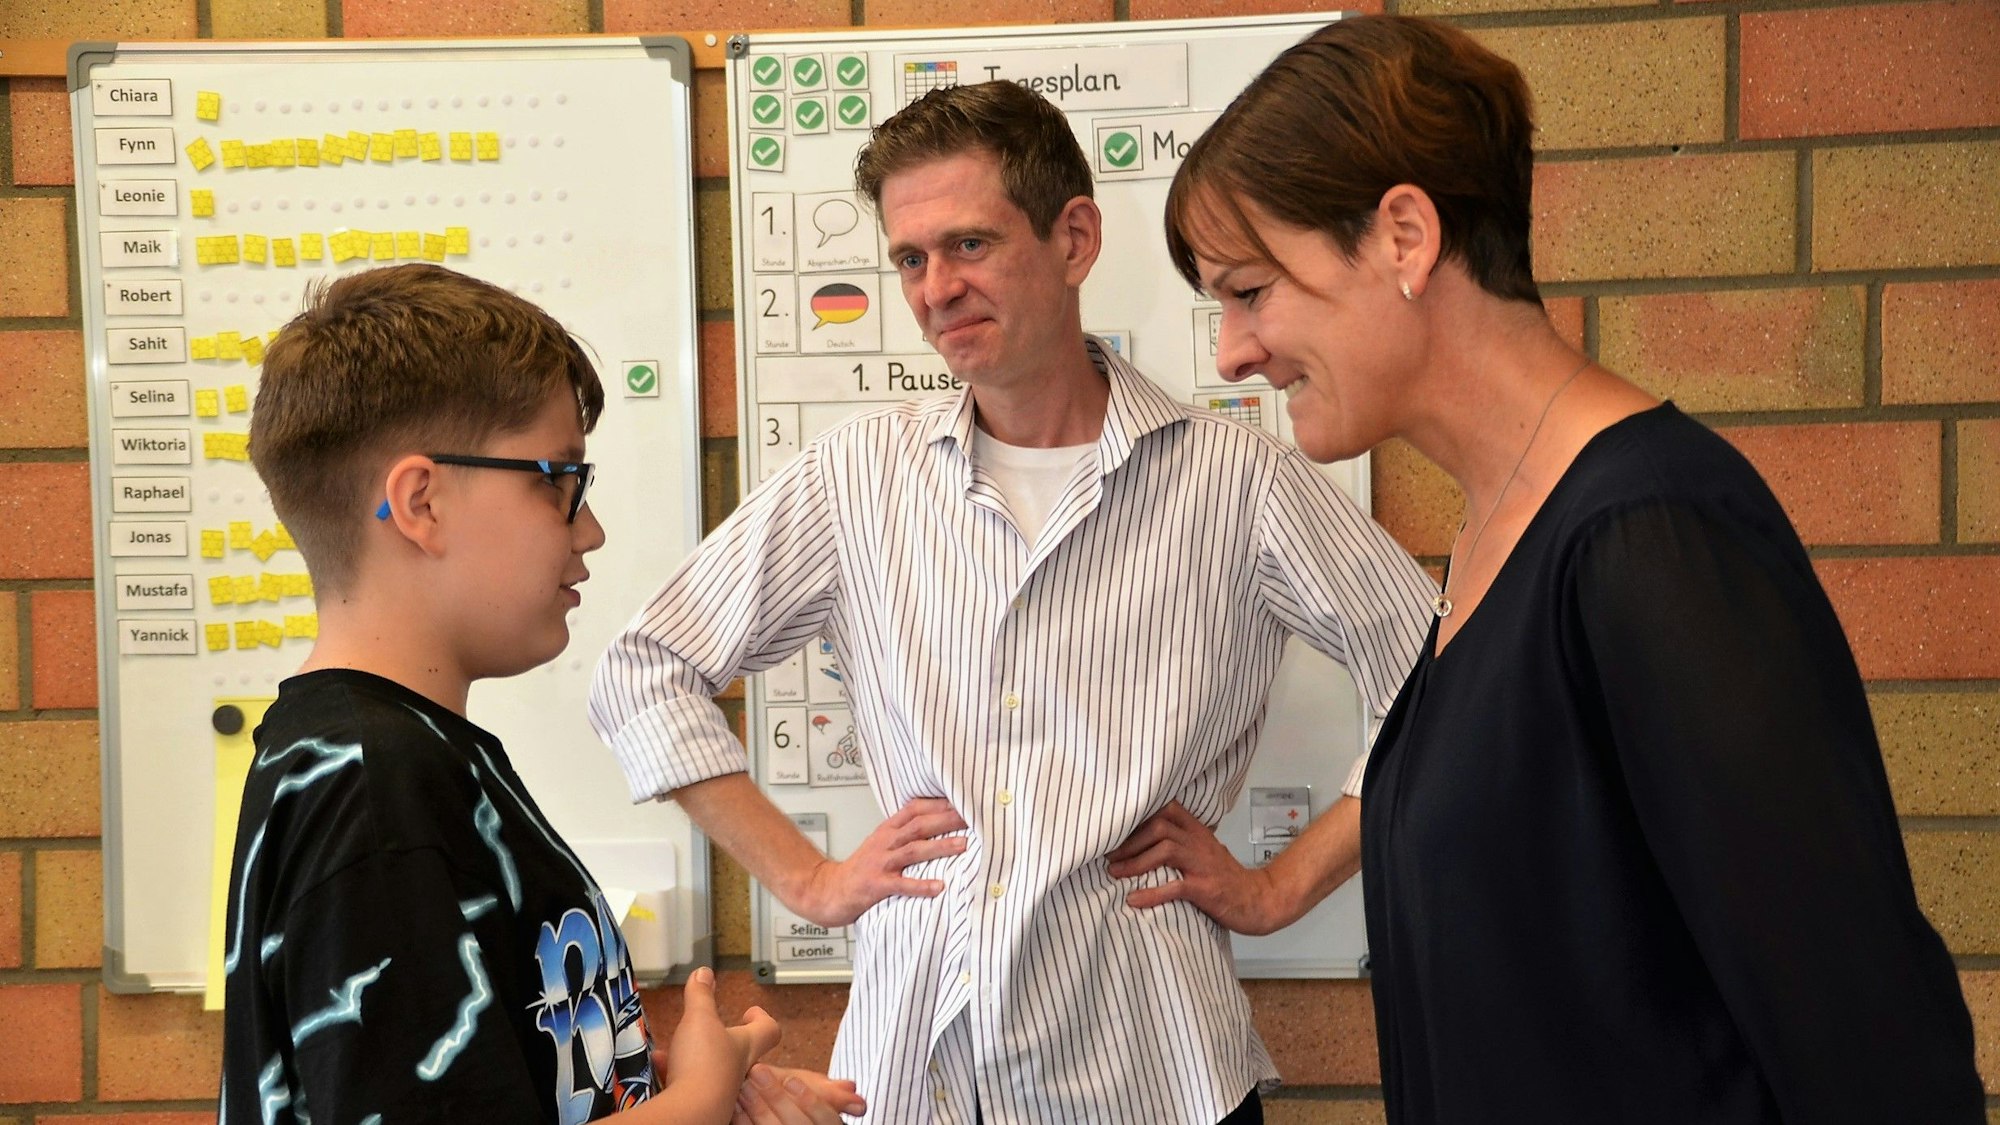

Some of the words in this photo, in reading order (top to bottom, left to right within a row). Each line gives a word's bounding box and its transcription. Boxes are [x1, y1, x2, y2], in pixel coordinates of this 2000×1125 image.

[109, 88, 158, 103] Chiara
[119, 137, 156, 154] Fynn
[1153, 129, 1191, 160] Mo
[114, 189, 165, 203] Leonie
[761, 206, 787, 236] 1.
[123, 240, 162, 254] Maik
[120, 289, 172, 303] Robert
[761, 288, 789, 318] 2.
[129, 337, 168, 351] Sahit
[826, 339, 856, 349] Deutsch
[852, 363, 870, 392] 1.
[888, 362, 963, 392] Pause
[129, 390, 175, 404] Selina
[765, 417, 793, 447] 3.
[121, 438, 187, 452] Wiktoria
[123, 485, 185, 502] Raphael
[129, 530, 172, 544] Jonas
[126, 583, 189, 598] Mustafa
[131, 628, 189, 642] Yannick
[773, 720, 801, 749] 6.
[791, 924, 829, 936] Selina
[792, 945, 834, 957] Leonie
